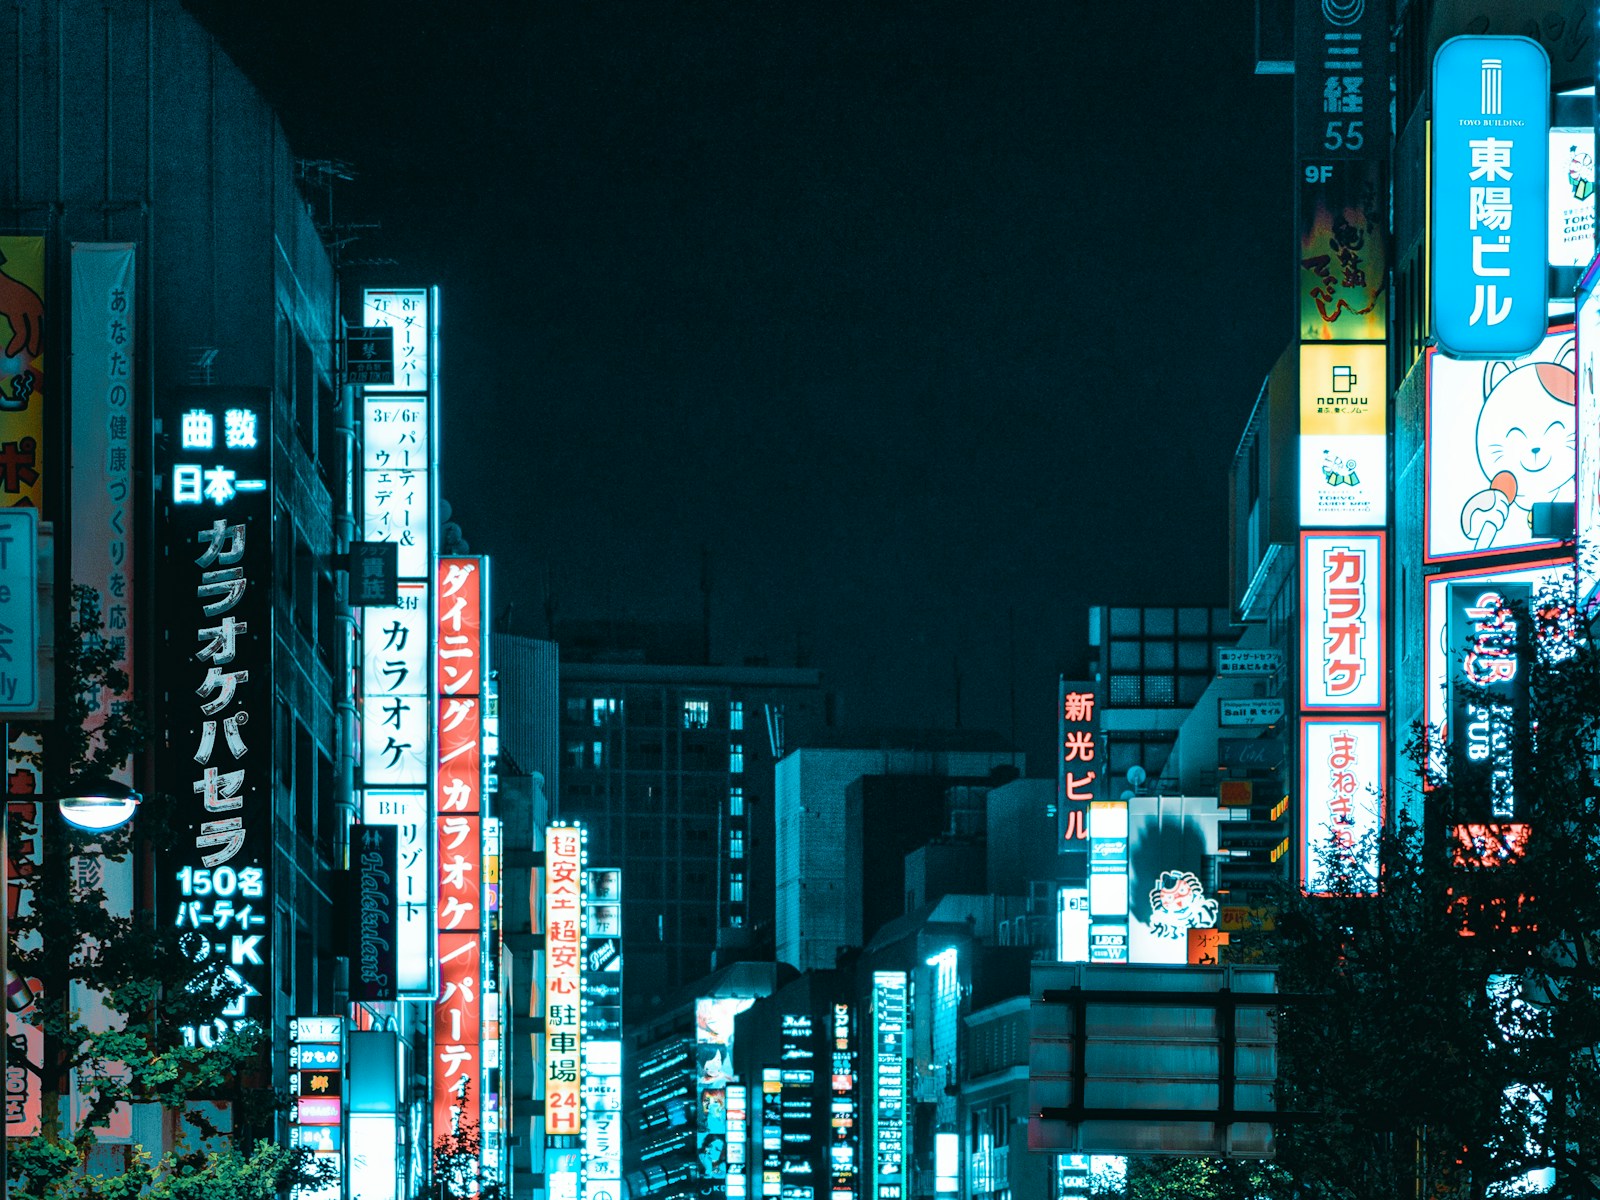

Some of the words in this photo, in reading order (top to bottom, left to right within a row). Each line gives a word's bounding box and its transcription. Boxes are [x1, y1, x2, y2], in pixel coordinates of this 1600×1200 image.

[1305, 166, 1333, 183] 9F
[1468, 137, 1514, 326] 東陽ビル
[374, 299, 391, 311] 7F
[402, 299, 420, 311] 8F
[402, 316, 417, 387] ダーツバー
[1317, 397, 1368, 405] nomuu
[173, 464, 266, 505] 日本一
[1327, 551, 1363, 695] カラオケ
[193, 518, 249, 868] カラオケパセラ
[381, 621, 413, 769] カラオケ
[1064, 691, 1095, 841] 新光ビル
[176, 866, 265, 897] 150名
[401, 824, 423, 922] リゾート
[552, 836, 578, 910] 超安全
[175, 900, 265, 931] パーティー
[550, 920, 577, 994] 超安心
[301, 1050, 339, 1063] かもめ
[549, 1004, 577, 1083] 駐車場
